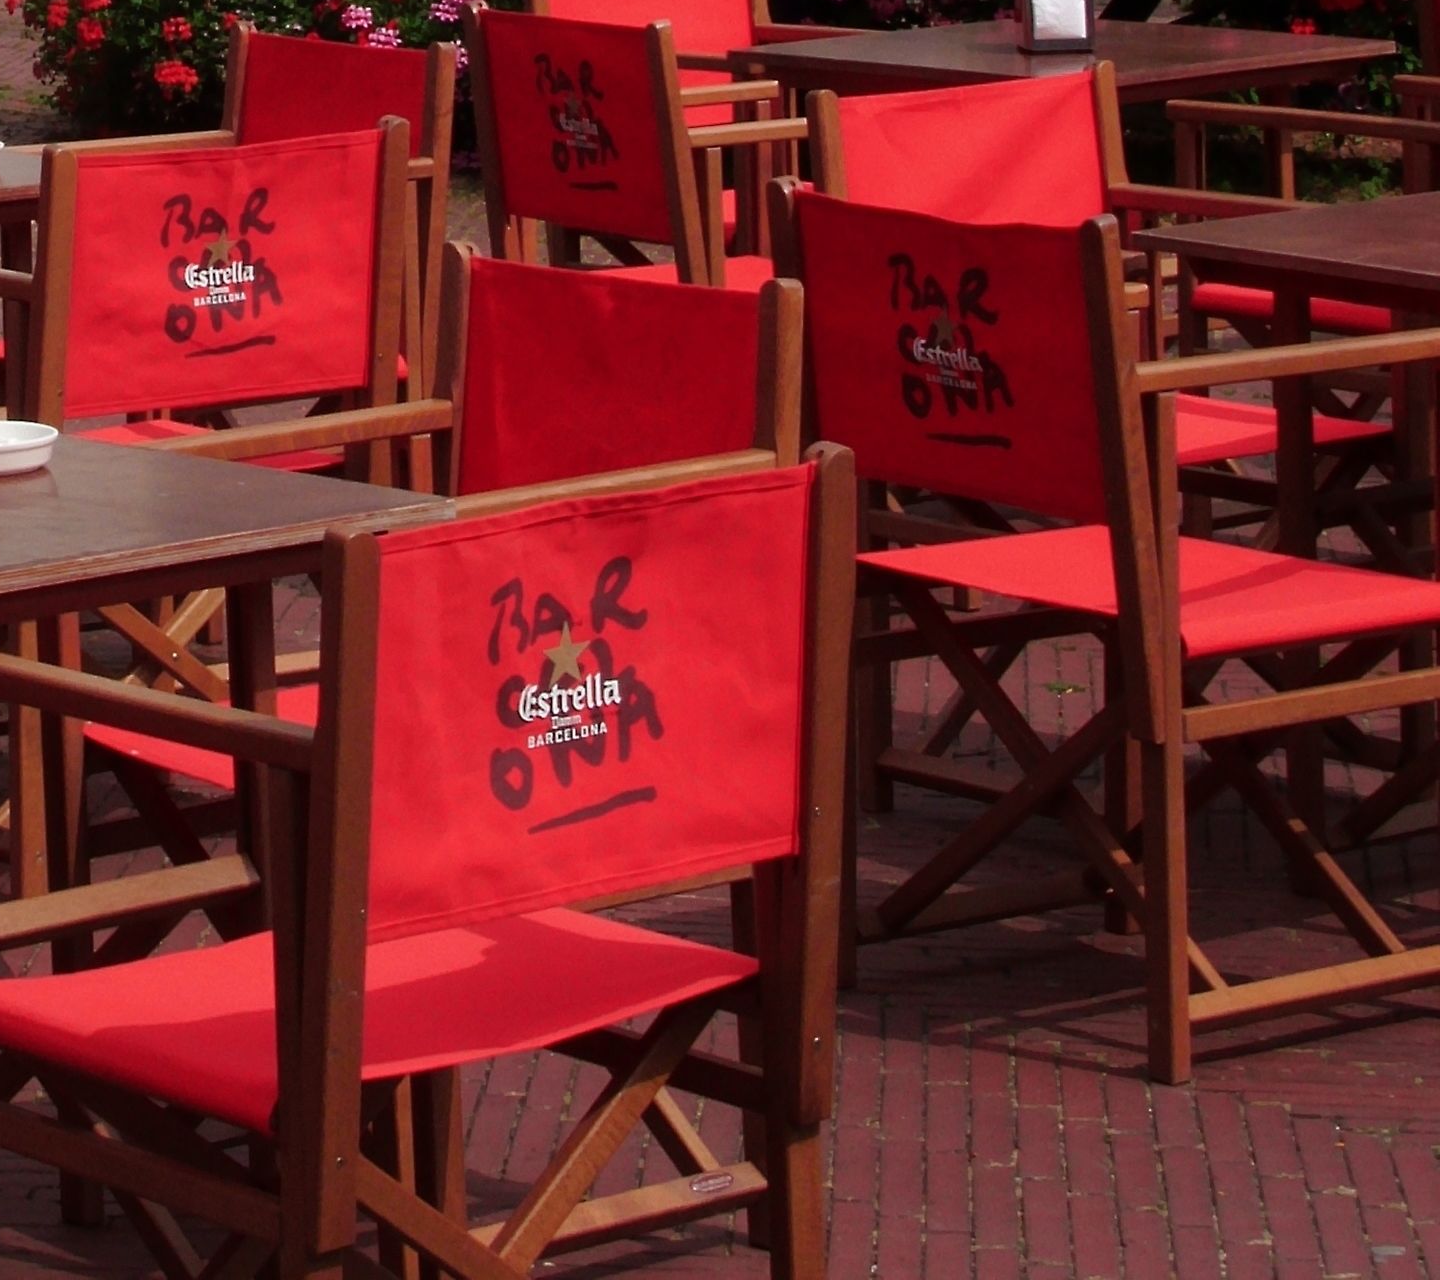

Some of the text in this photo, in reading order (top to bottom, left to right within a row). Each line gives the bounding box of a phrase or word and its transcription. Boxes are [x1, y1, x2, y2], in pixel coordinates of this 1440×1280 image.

[160, 187, 276, 248] BAR
[184, 261, 255, 289] Estrella
[887, 252, 999, 326] BAR
[193, 291, 247, 307] BARCELONA
[913, 336, 983, 373] Estrella
[488, 556, 648, 665] BAR
[518, 672, 622, 722] Estrella
[527, 722, 608, 749] BARCELONA
